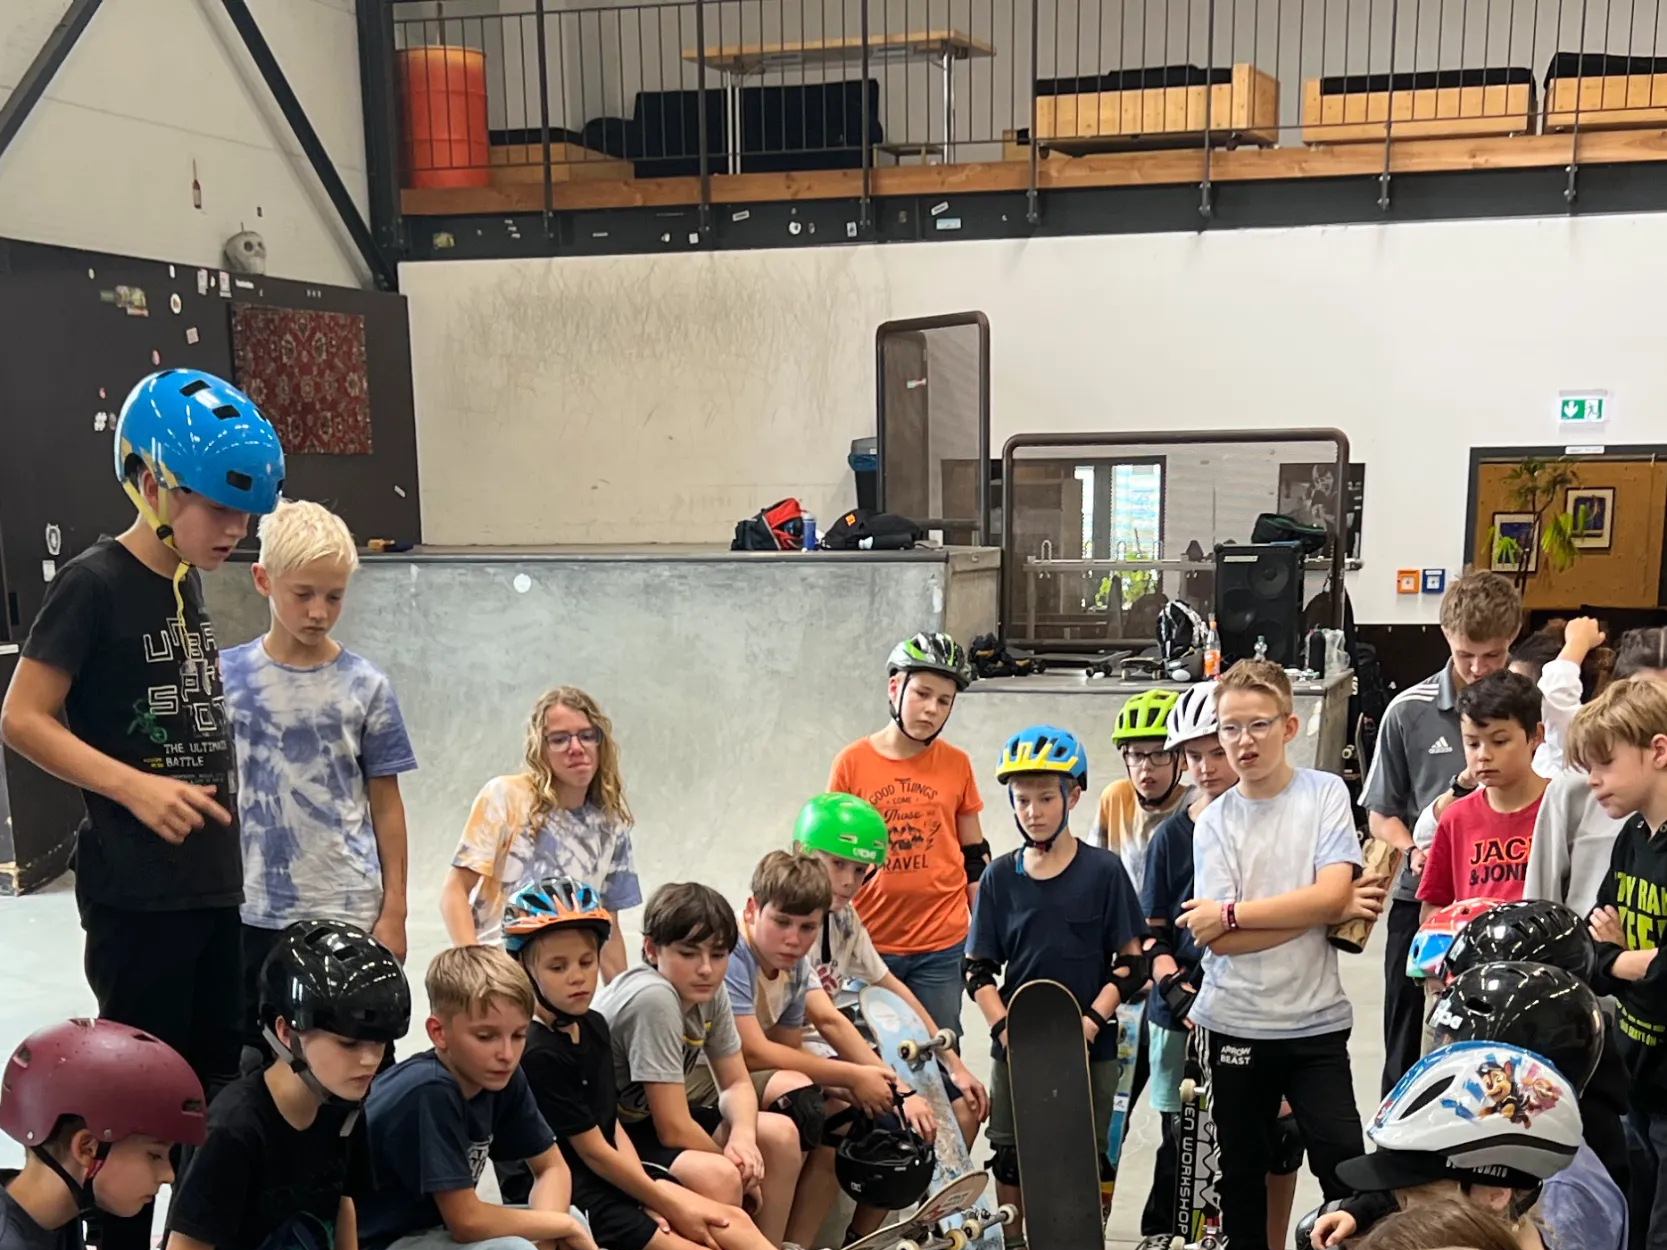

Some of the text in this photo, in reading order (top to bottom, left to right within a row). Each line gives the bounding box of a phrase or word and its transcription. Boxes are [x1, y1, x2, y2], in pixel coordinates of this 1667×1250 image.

[164, 742, 184, 754] THE
[165, 757, 205, 767] BATTLE
[869, 784, 896, 805] GOOD
[1470, 837, 1532, 865] JAC
[883, 854, 929, 872] RAVEL
[1220, 1054, 1251, 1065] BEAST
[1177, 1136, 1194, 1235] WORKSHOP
